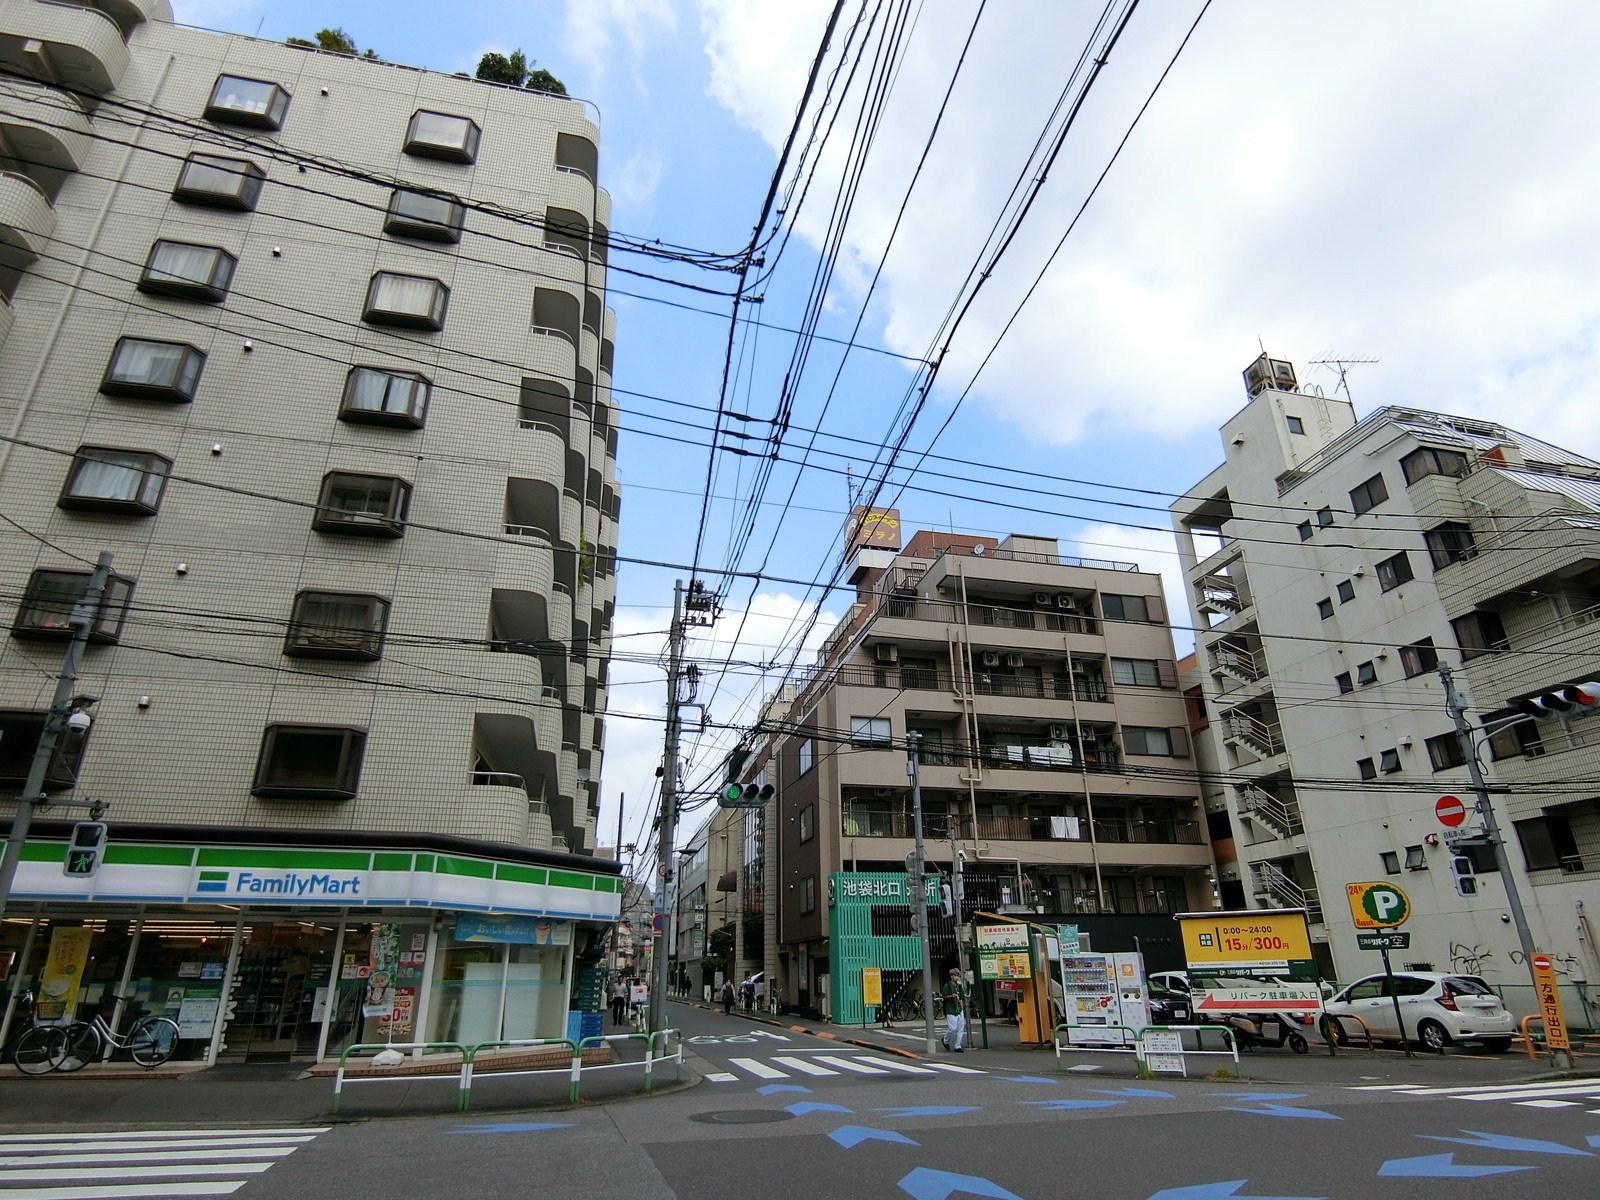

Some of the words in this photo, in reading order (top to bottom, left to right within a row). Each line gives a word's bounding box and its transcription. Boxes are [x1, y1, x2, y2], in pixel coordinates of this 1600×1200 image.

[863, 529, 896, 541] ミラノ
[236, 872, 361, 896] FamilyMart
[843, 881, 901, 897] 池袋北口
[1348, 885, 1363, 895] 24h
[1372, 890, 1398, 919] P
[1355, 918, 1374, 927] Repark
[1389, 935, 1405, 947] 空
[1230, 991, 1319, 1000] リパーク駐車場入口
[1539, 975, 1562, 1038] 一方通行出口
